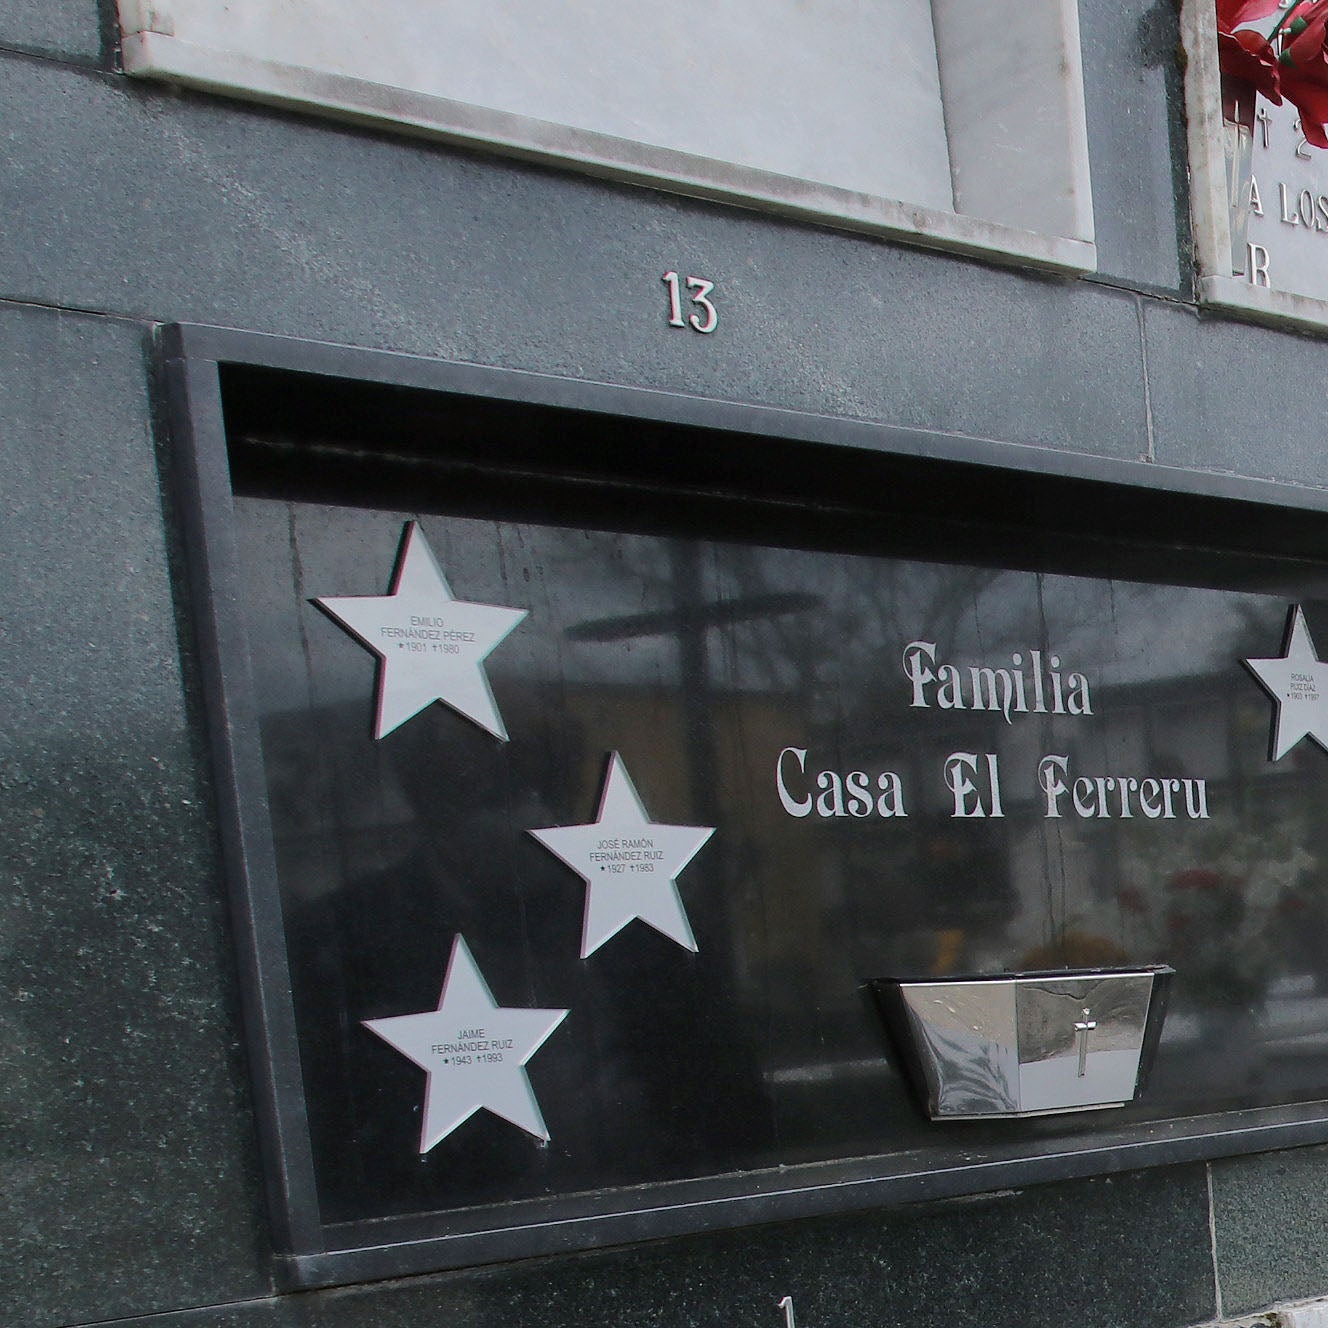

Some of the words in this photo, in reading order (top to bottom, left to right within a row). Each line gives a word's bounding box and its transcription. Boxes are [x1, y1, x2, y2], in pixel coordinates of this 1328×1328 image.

[1248, 173, 1265, 217] A
[1248, 242, 1271, 288] R
[662, 271, 718, 333] 13
[410, 615, 445, 628] EMILIO
[380, 626, 441, 641] FERNÁNDEZ
[443, 628, 476, 642] PÉREZ
[902, 640, 1095, 725] Familia
[776, 746, 908, 819] Casa
[943, 752, 1006, 819] El
[1037, 754, 1211, 820] Ferreru
[597, 838, 620, 850] JOSÉ
[621, 837, 654, 849] RAMÓN
[589, 849, 642, 862] FERNÁNDEZ
[643, 850, 665, 861] RUIZ
[607, 863, 626, 874] 1927
[457, 1028, 486, 1040] JAIME
[431, 1040, 490, 1054] FERNÁNDEZ
[491, 1039, 514, 1050] RUIZ
[451, 1055, 473, 1066] 1943
